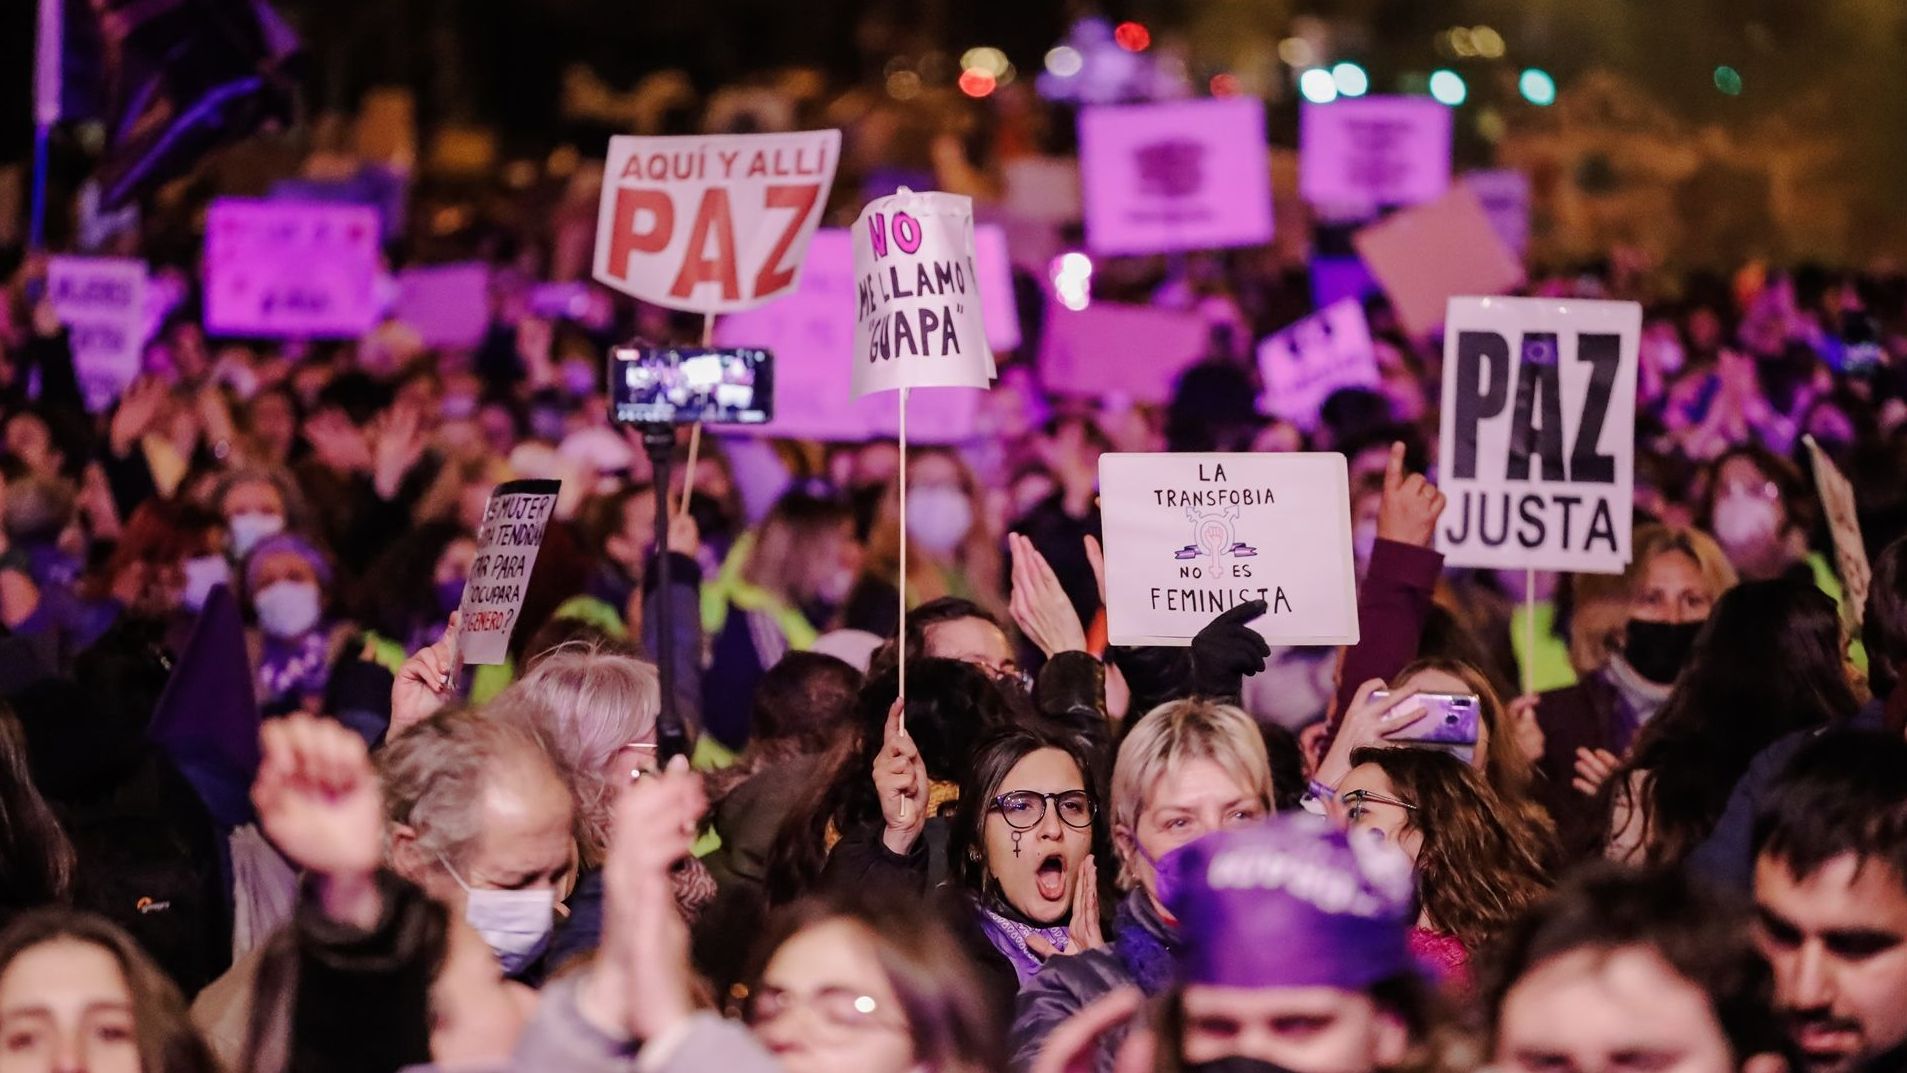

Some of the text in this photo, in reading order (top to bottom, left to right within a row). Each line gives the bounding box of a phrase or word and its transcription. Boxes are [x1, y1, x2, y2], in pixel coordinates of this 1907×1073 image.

[621, 140, 827, 181] AQUÍ Y ALLÍ
[607, 183, 821, 302] PAZ
[868, 211, 922, 261] NO
[859, 274, 876, 322] ME
[878, 261, 965, 302] LLAMO
[1453, 331, 1621, 483] PAZ
[1199, 463, 1227, 482] LA
[498, 495, 550, 519] MUJER
[1154, 488, 1276, 507] TRANSFOBIA
[1446, 492, 1618, 552] JUSTA
[491, 554, 525, 580] PARA
[1180, 564, 1252, 579] NO ES
[1151, 586, 1293, 614] FEMINISTA
